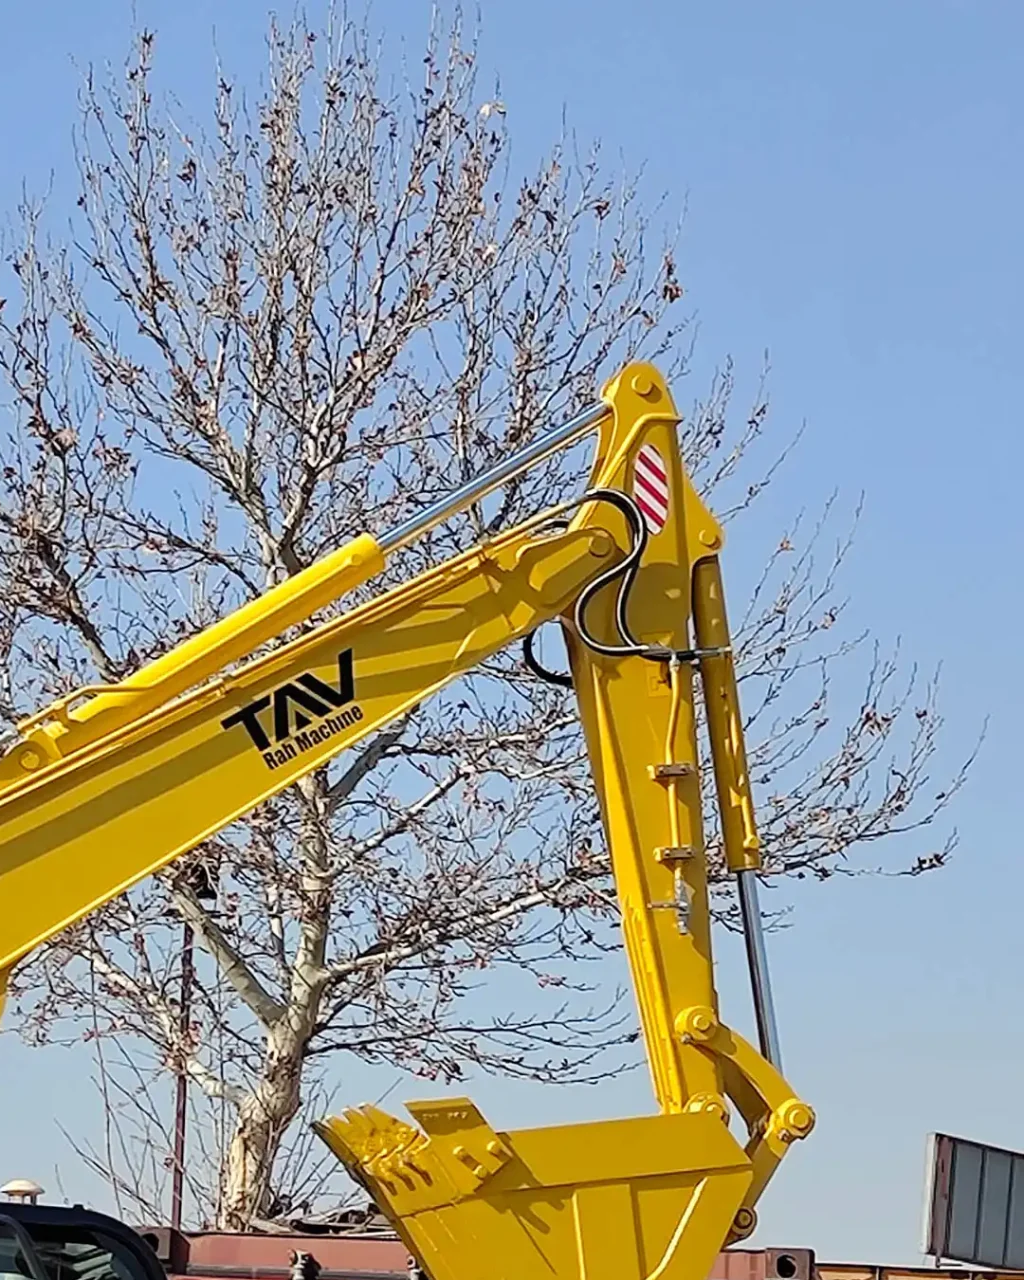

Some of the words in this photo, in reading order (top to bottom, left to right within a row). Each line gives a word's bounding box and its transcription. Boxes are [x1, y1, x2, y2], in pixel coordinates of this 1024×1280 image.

[220, 648, 355, 752] TAV
[262, 741, 298, 771] Rah
[295, 705, 364, 753] Machine
